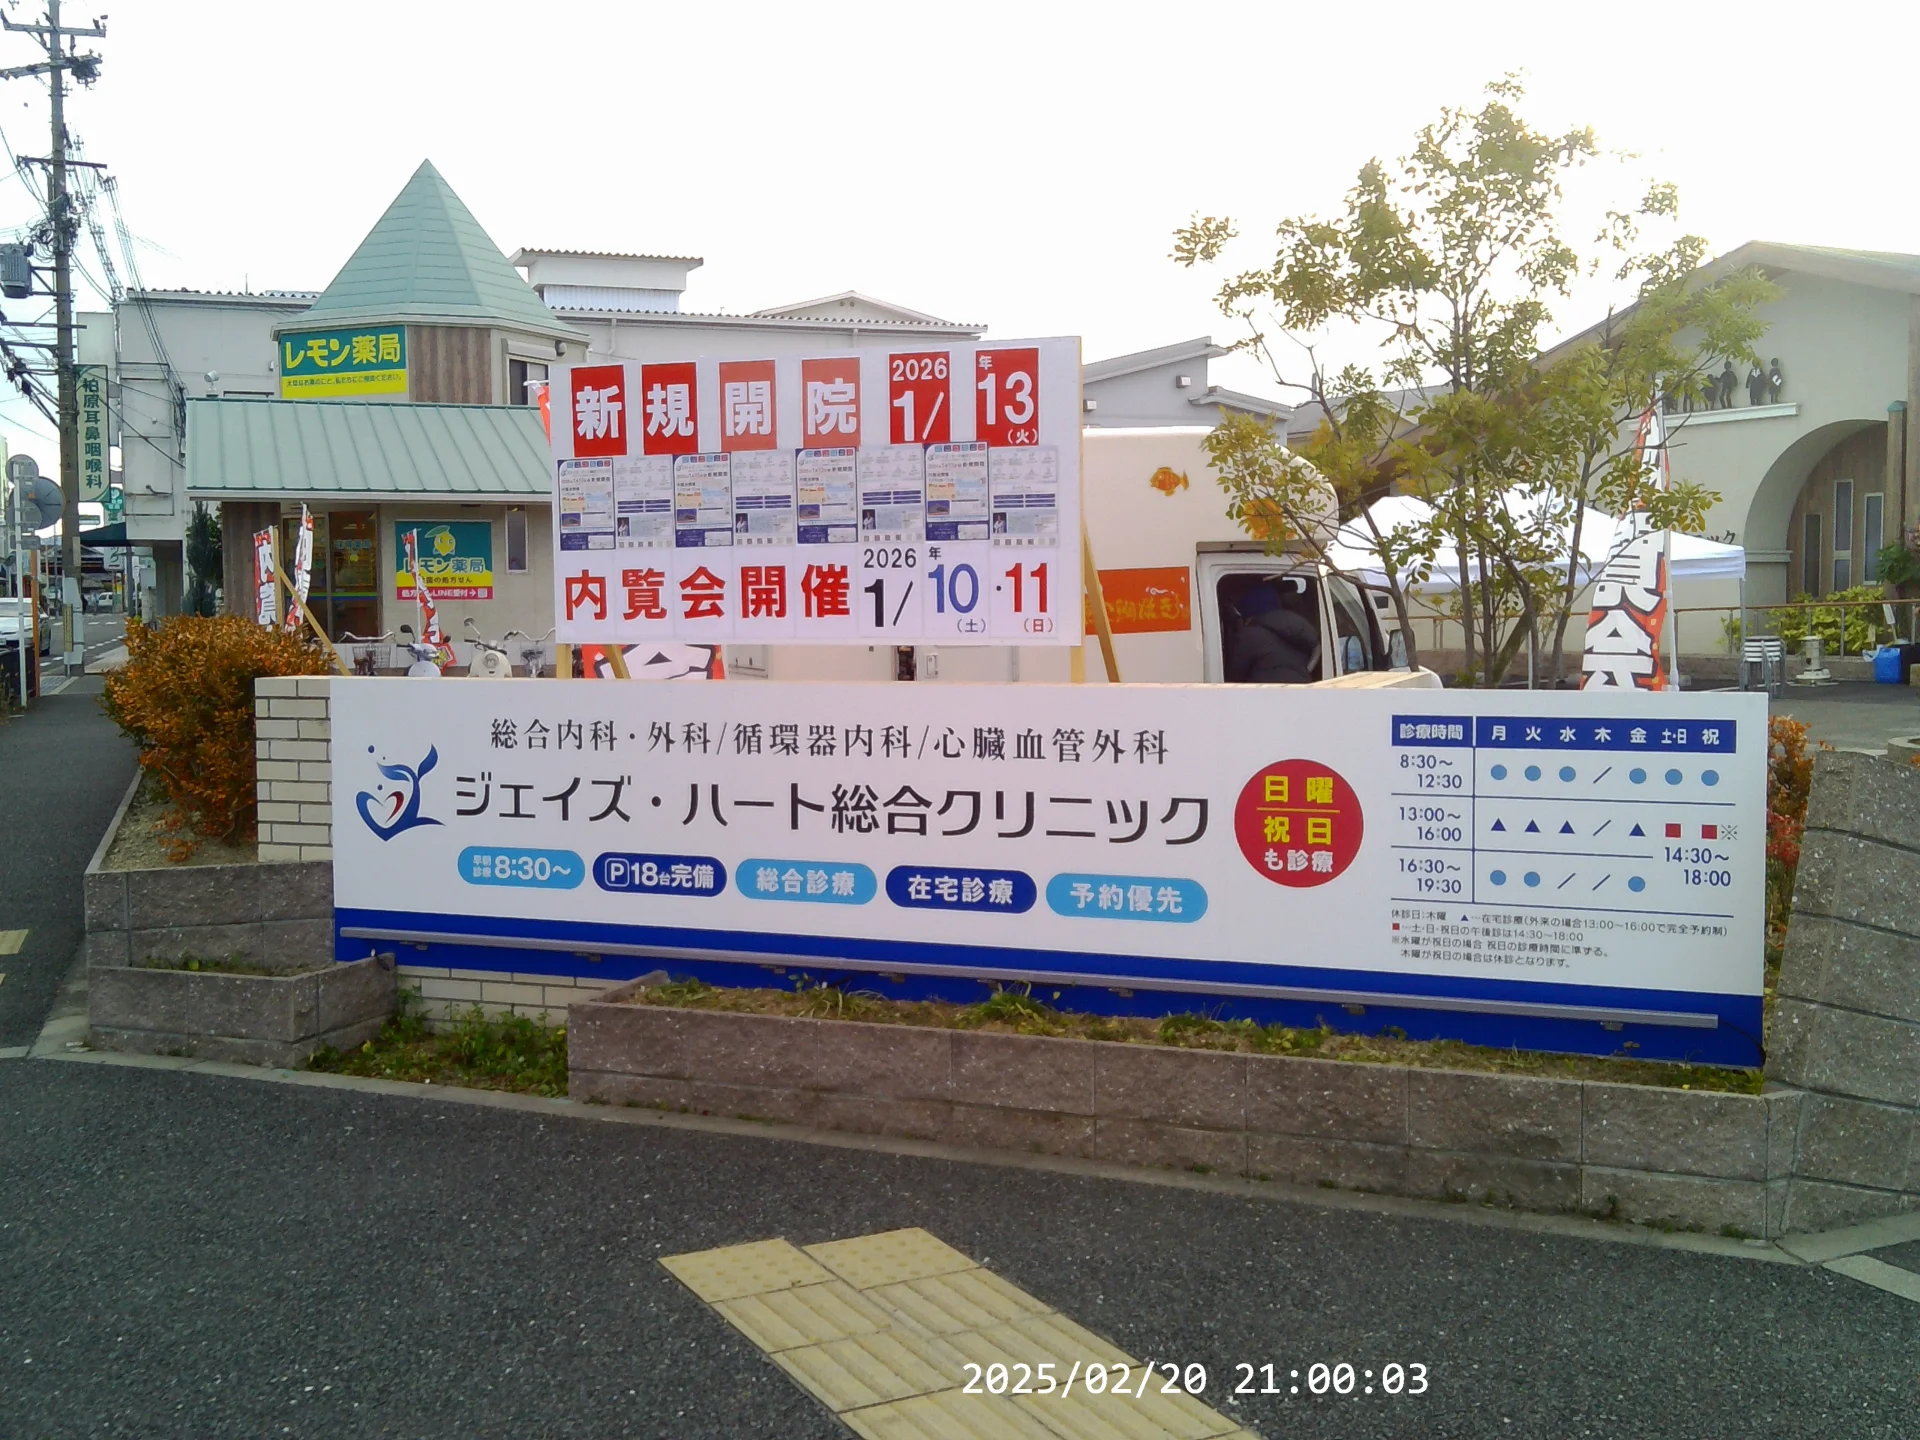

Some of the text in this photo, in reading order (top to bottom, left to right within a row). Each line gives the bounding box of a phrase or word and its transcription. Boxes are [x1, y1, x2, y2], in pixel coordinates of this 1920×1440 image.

[286, 333, 401, 369] レモン薬局
[576, 378, 858, 440] 新規開院
[83, 378, 103, 490] 柏原耳鼻咽喉科
[422, 576, 473, 584] 国の処方せん
[564, 564, 851, 622] 内覧会開催
[1399, 722, 1464, 741] 診療時間
[1491, 725, 1507, 741] 月
[1525, 725, 1542, 742] 火
[1559, 726, 1576, 742] 水
[1594, 727, 1612, 743] 木
[1630, 727, 1647, 744] 金
[1702, 729, 1719, 745] 祝
[1263, 775, 1334, 805] 日曜
[1417, 774, 1463, 790] 12:30
[1263, 816, 1333, 845] 祝日
[1417, 826, 1463, 843] 16:00
[1263, 849, 1334, 873] も診療
[756, 866, 856, 897] 総合診療
[907, 875, 1014, 905] 在宅診療
[1417, 878, 1463, 895] 19:30
[1683, 868, 1732, 887] 18:00
[1070, 883, 1184, 914] 予約優先
